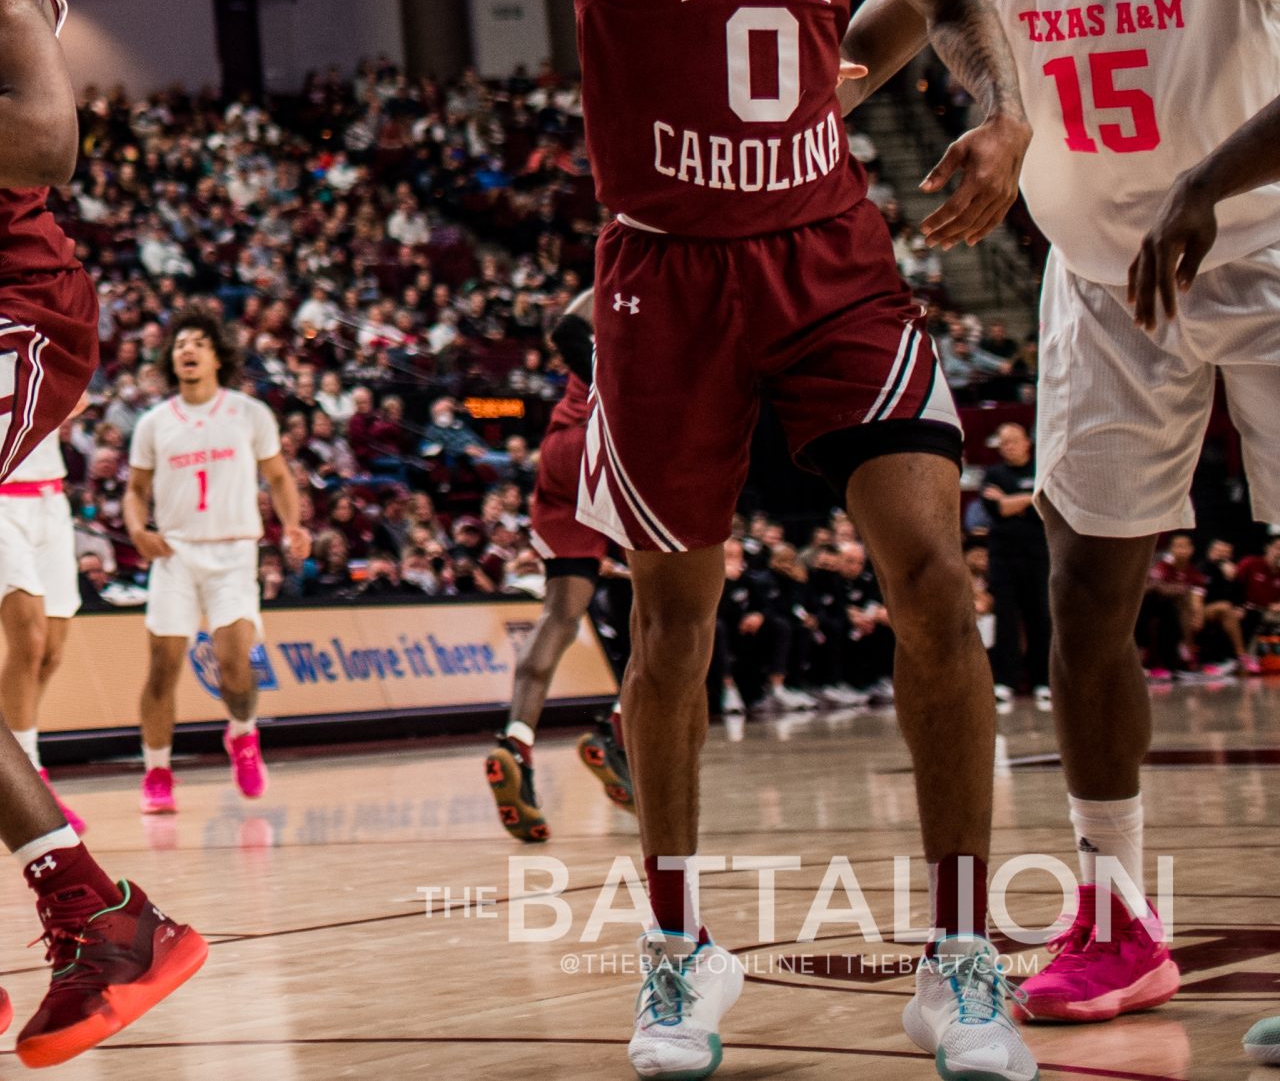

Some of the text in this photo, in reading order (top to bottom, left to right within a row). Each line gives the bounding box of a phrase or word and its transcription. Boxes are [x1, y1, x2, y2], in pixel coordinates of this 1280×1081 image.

[1019, 4, 1105, 42] TEXAS
[726, 7, 799, 122] 0
[1043, 49, 1161, 153] 15
[653, 111, 840, 192] CAROLINA
[195, 471, 207, 512] 1
[278, 642, 337, 683] We
[331, 638, 401, 680] love
[400, 633, 434, 677] it
[427, 635, 508, 676] here.
